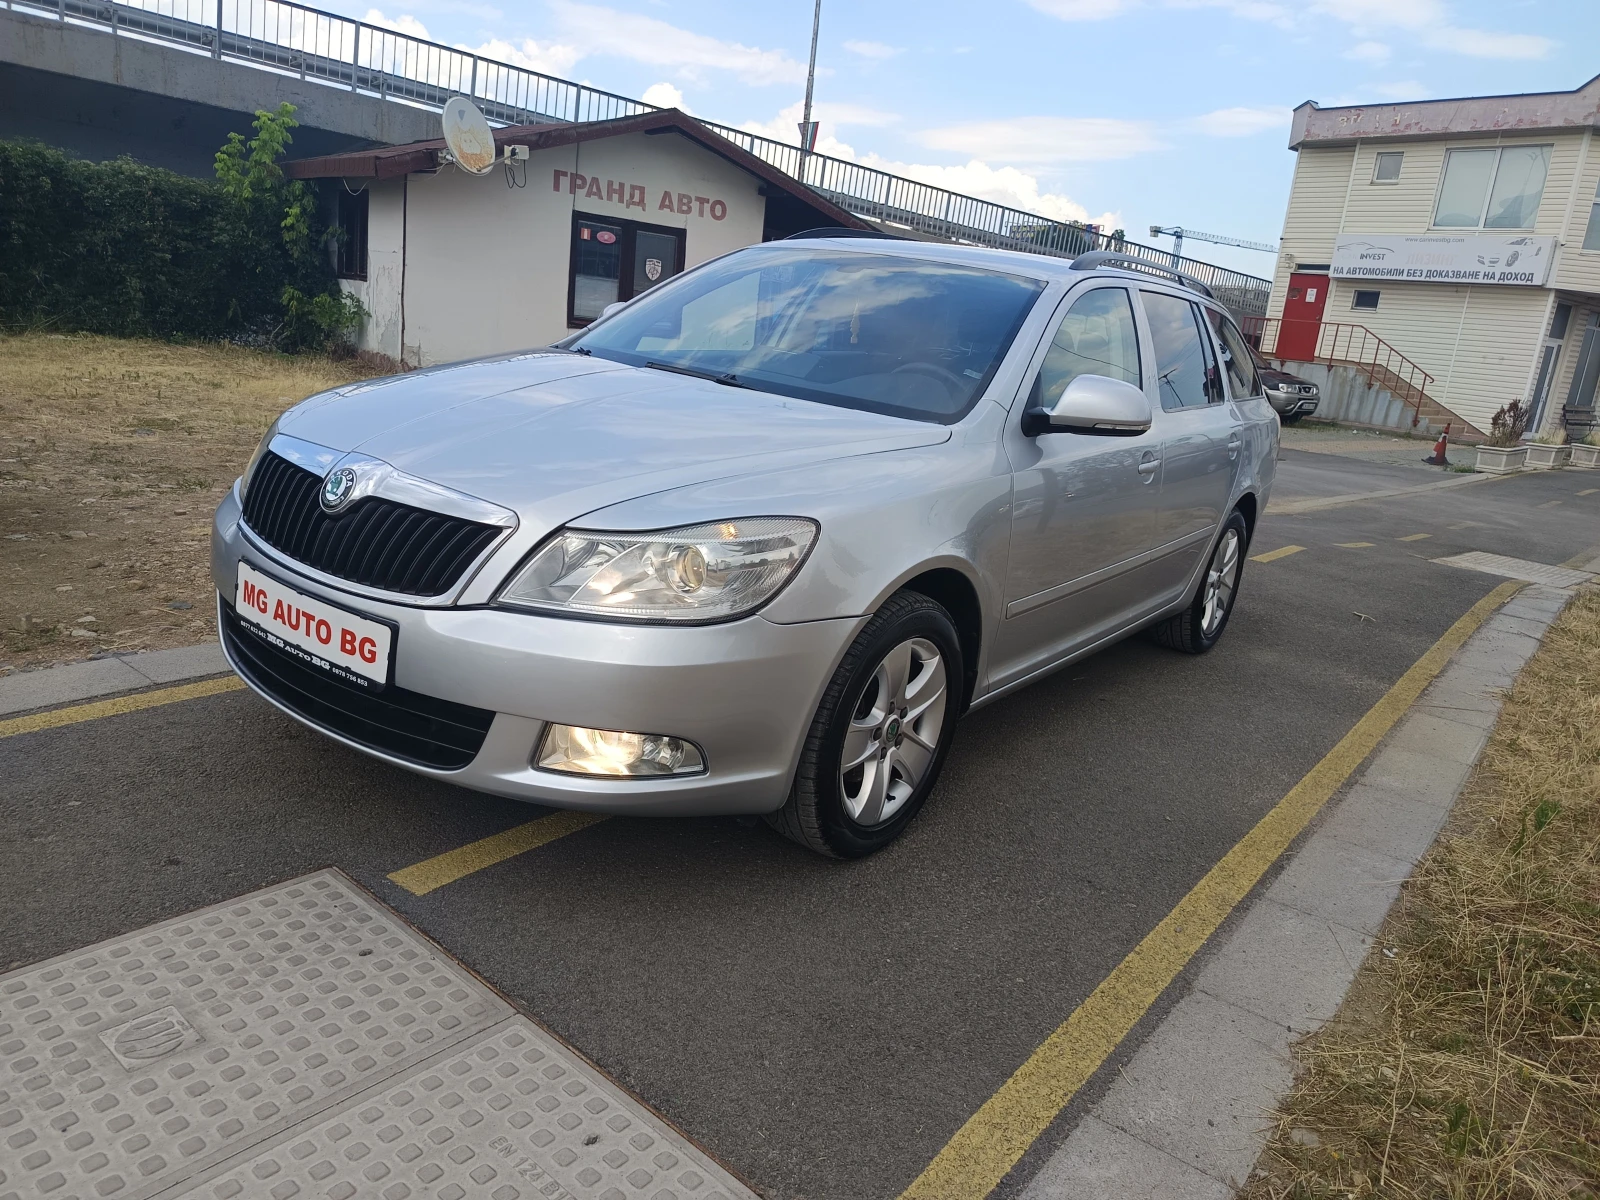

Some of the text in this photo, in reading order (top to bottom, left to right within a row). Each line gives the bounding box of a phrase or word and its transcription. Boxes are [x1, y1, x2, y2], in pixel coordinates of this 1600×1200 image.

[553, 169, 727, 221] ГРАНД АВТО
[1359, 253, 1386, 261] INVEST
[1333, 266, 1534, 284] НА АВТОМОБИЛИ БЕЗ ДОКАЗВАНЕ НА ДОХОД
[243, 579, 377, 664] MG AUTO BG
[266, 632, 285, 649] MG
[284, 645, 311, 662] AUTO
[311, 655, 331, 671] BG
[488, 1135, 518, 1158] EN
